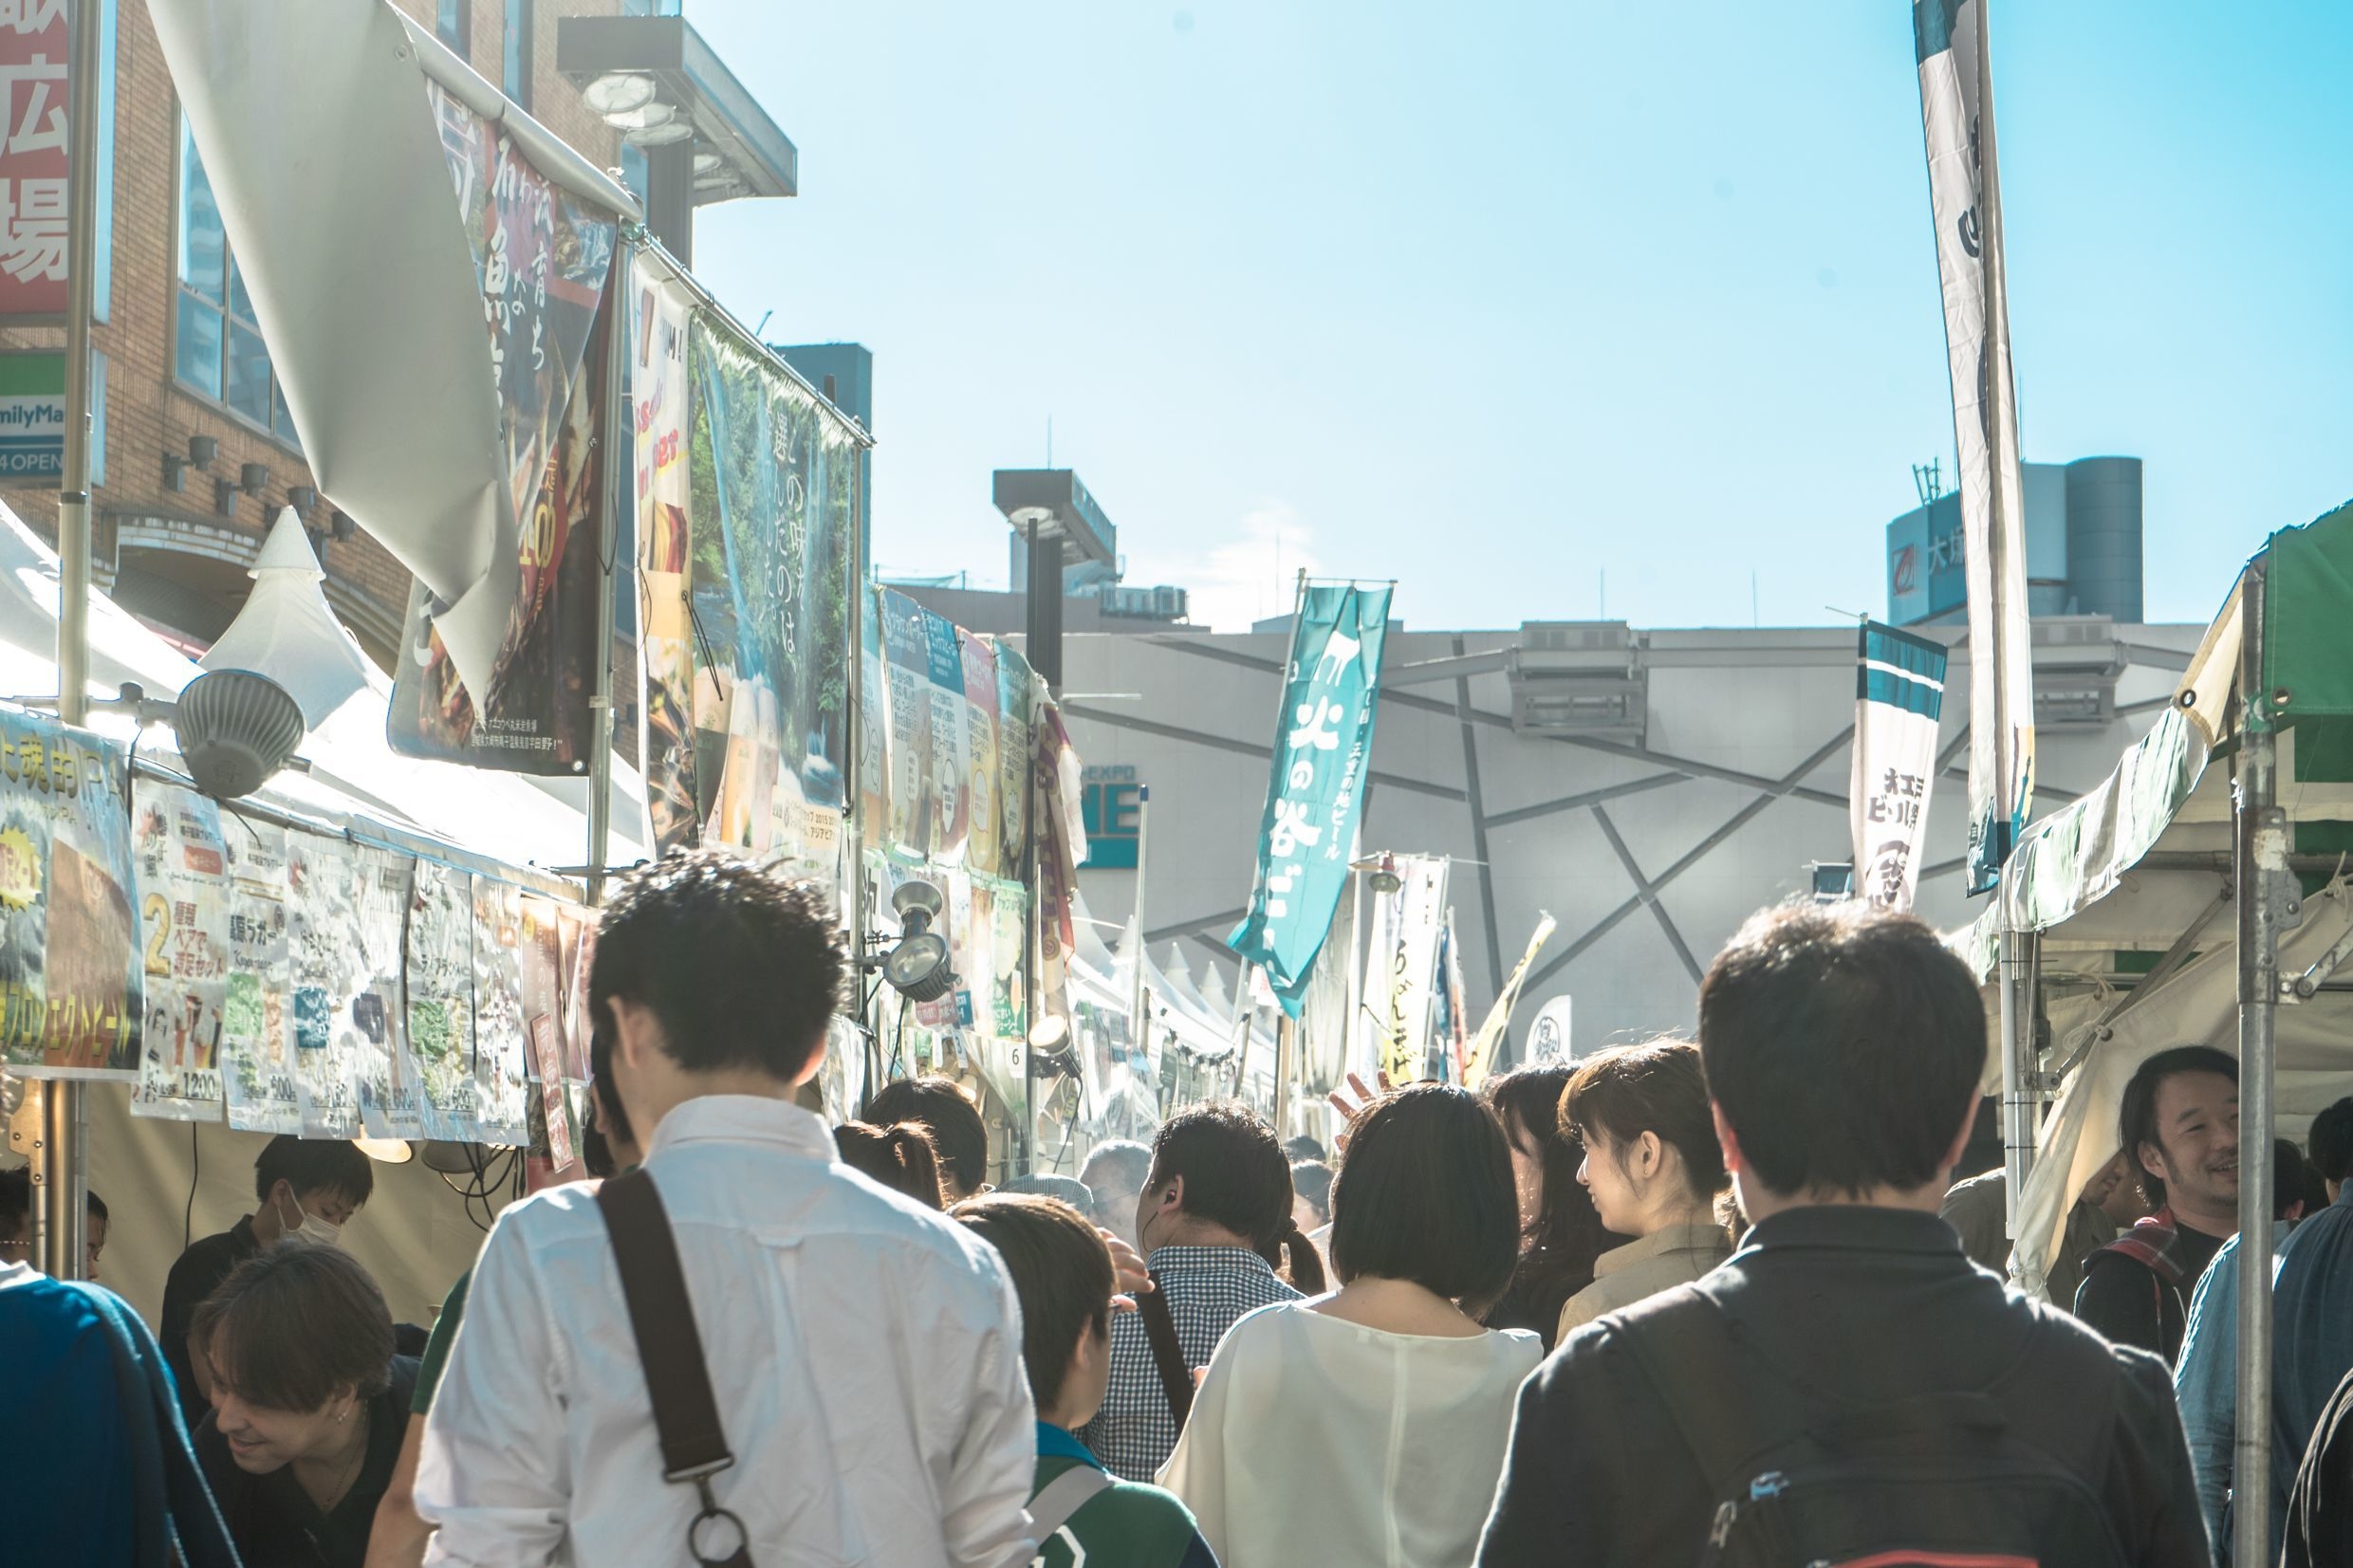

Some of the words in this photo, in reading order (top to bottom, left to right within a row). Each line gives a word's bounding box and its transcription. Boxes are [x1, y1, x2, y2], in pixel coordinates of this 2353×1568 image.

[10, 453, 64, 471] OPEN
[143, 892, 172, 979] 2
[174, 929, 208, 952] ペアで
[1011, 1049, 1020, 1067] 6
